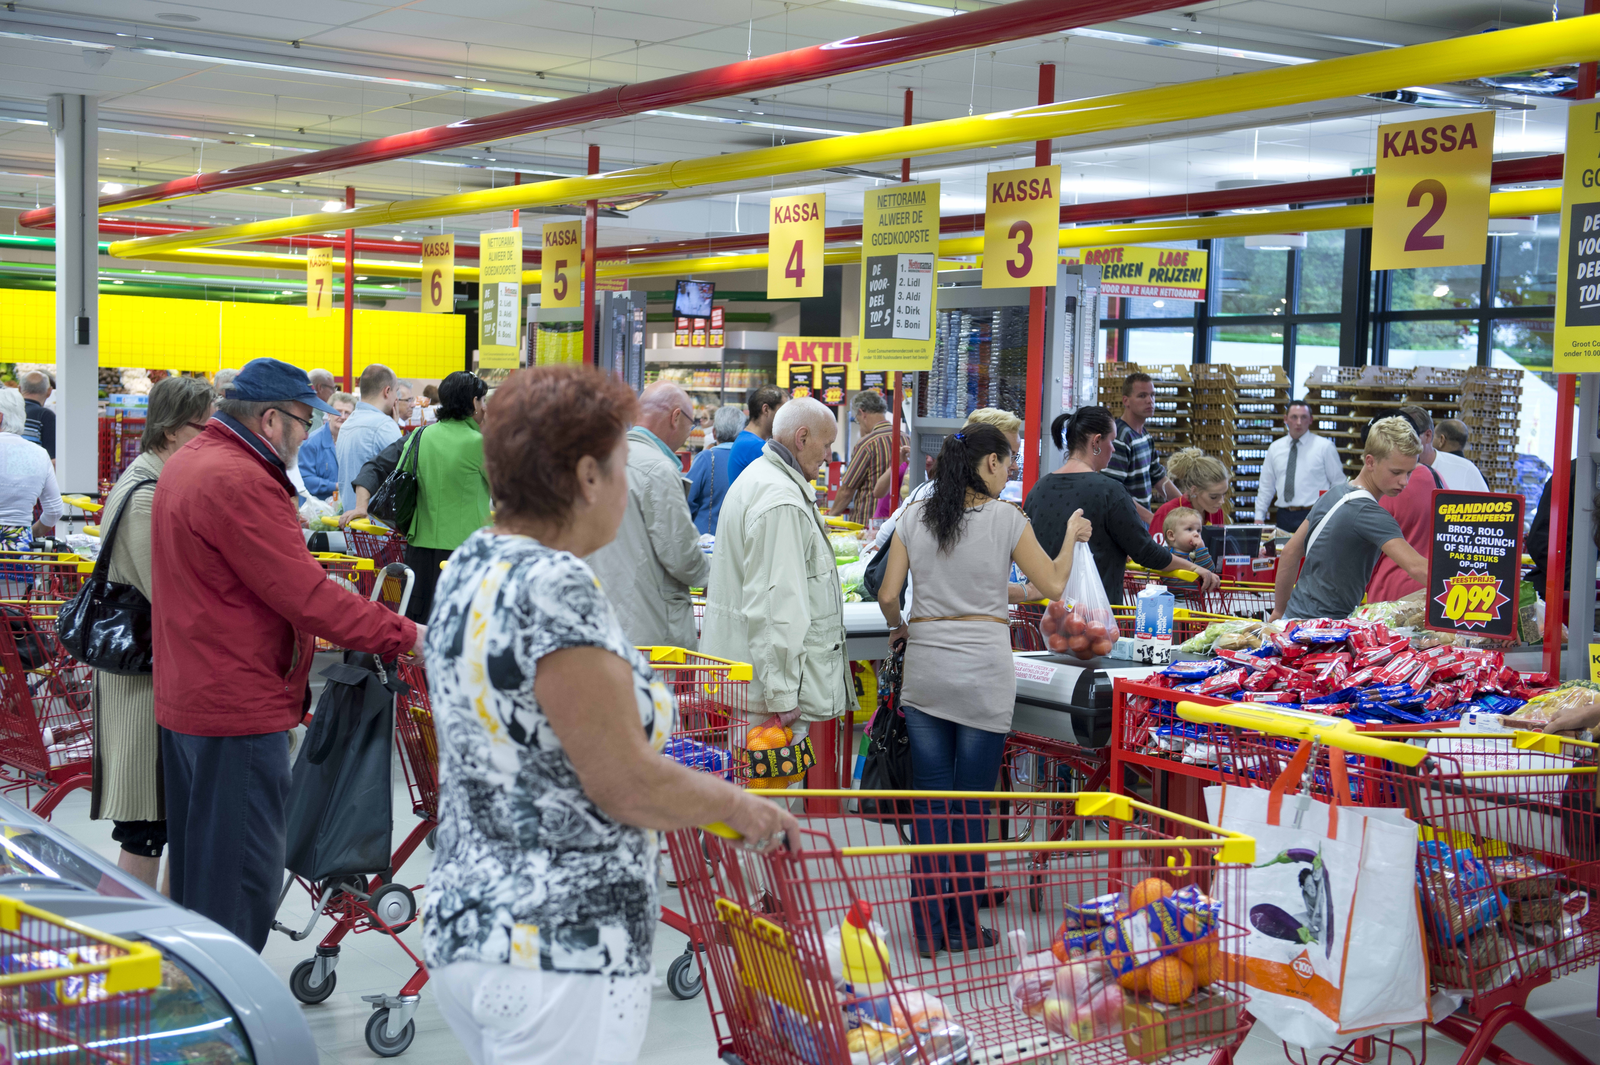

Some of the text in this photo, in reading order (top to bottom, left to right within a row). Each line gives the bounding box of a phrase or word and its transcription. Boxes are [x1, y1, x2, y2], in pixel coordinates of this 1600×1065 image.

[1383, 123, 1478, 158] KASSA
[992, 177, 1053, 203] KASSA
[877, 190, 926, 208] NETTORAMA
[775, 202, 819, 224] KASSA
[878, 210, 923, 227] ALWEER DE
[1403, 178, 1447, 251] 2
[488, 236, 514, 248] NETTORAMA
[545, 229, 578, 248] KASSA
[872, 229, 929, 246] GOEDKOOPSTE
[423, 241, 451, 258] KASSA
[1006, 220, 1033, 279] 3
[1085, 247, 1125, 265] GROTE
[1158, 251, 1189, 267] LAGE
[309, 253, 331, 268] KASSA
[785, 239, 805, 288] 4
[484, 264, 516, 276] GOEDKOOPSTE
[872, 263, 882, 276] DE
[1101, 262, 1203, 283] ERKEN PRIJZEN!
[430, 268, 443, 307] 6
[553, 259, 568, 301] 5
[869, 278, 890, 292] VOOR-
[899, 278, 920, 287] 2. Lidl
[315, 278, 325, 312] 7
[897, 292, 921, 301] 3. Aldi
[1121, 285, 1130, 294] GA
[1131, 285, 1139, 295] JE
[1140, 286, 1158, 296] NAAR
[1159, 287, 1199, 299] NETTORAMA!
[869, 294, 885, 308] DEEL
[870, 308, 891, 326] TOP 5
[896, 306, 920, 315] 4. Dirk
[896, 319, 920, 329] 5. Boni
[782, 341, 852, 362] AKTIE
[1572, 340, 1590, 348] Groot
[1438, 502, 1513, 515] GRANDIOOS
[1444, 514, 1515, 523] PRIJZENFEEST!
[1448, 525, 1504, 537] BROS, ROLO
[1436, 533, 1515, 548] KITKAT, CRUNCH
[1444, 543, 1506, 557] OF SMARTIES
[1449, 552, 1465, 560] PAK
[1473, 554, 1499, 563] STUKS
[1459, 560, 1487, 569] OP=OP!
[1452, 576, 1495, 584] FEESTPRIJS
[1293, 960, 1313, 976] C1000
